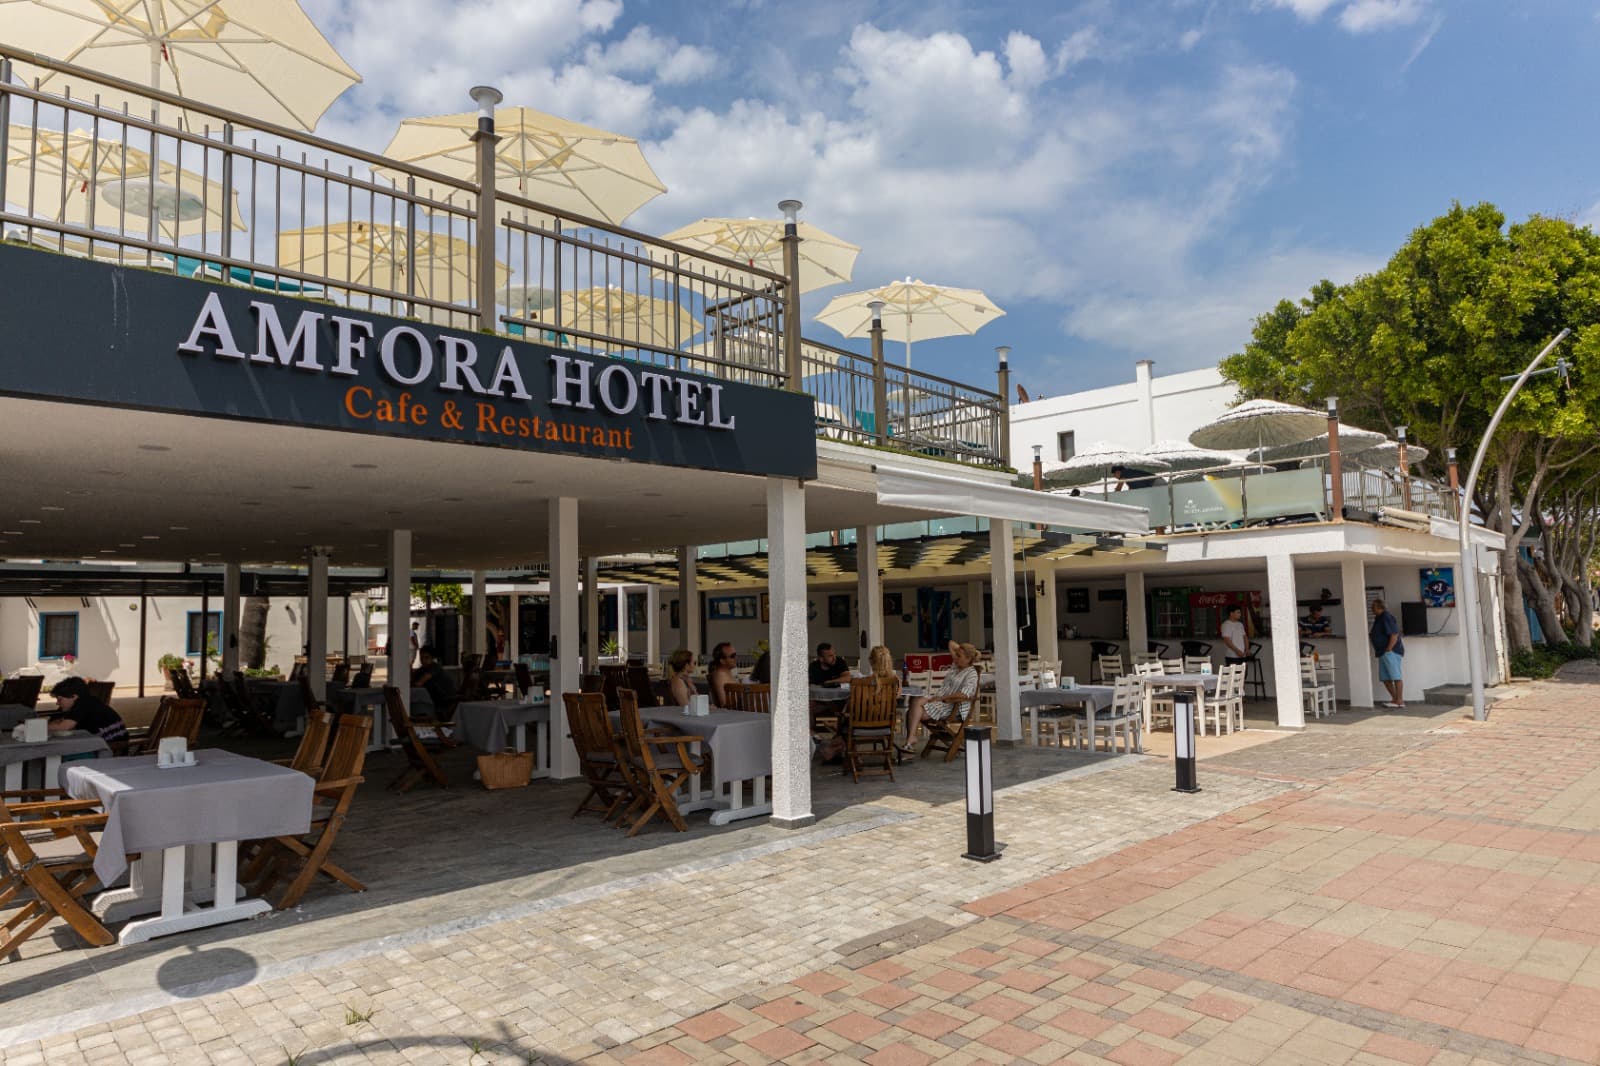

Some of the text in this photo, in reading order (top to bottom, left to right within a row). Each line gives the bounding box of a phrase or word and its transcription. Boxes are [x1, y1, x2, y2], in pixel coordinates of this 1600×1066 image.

[178, 291, 736, 431] AMFORA HOTEL
[344, 386, 634, 450] Cafe & Restaurant
